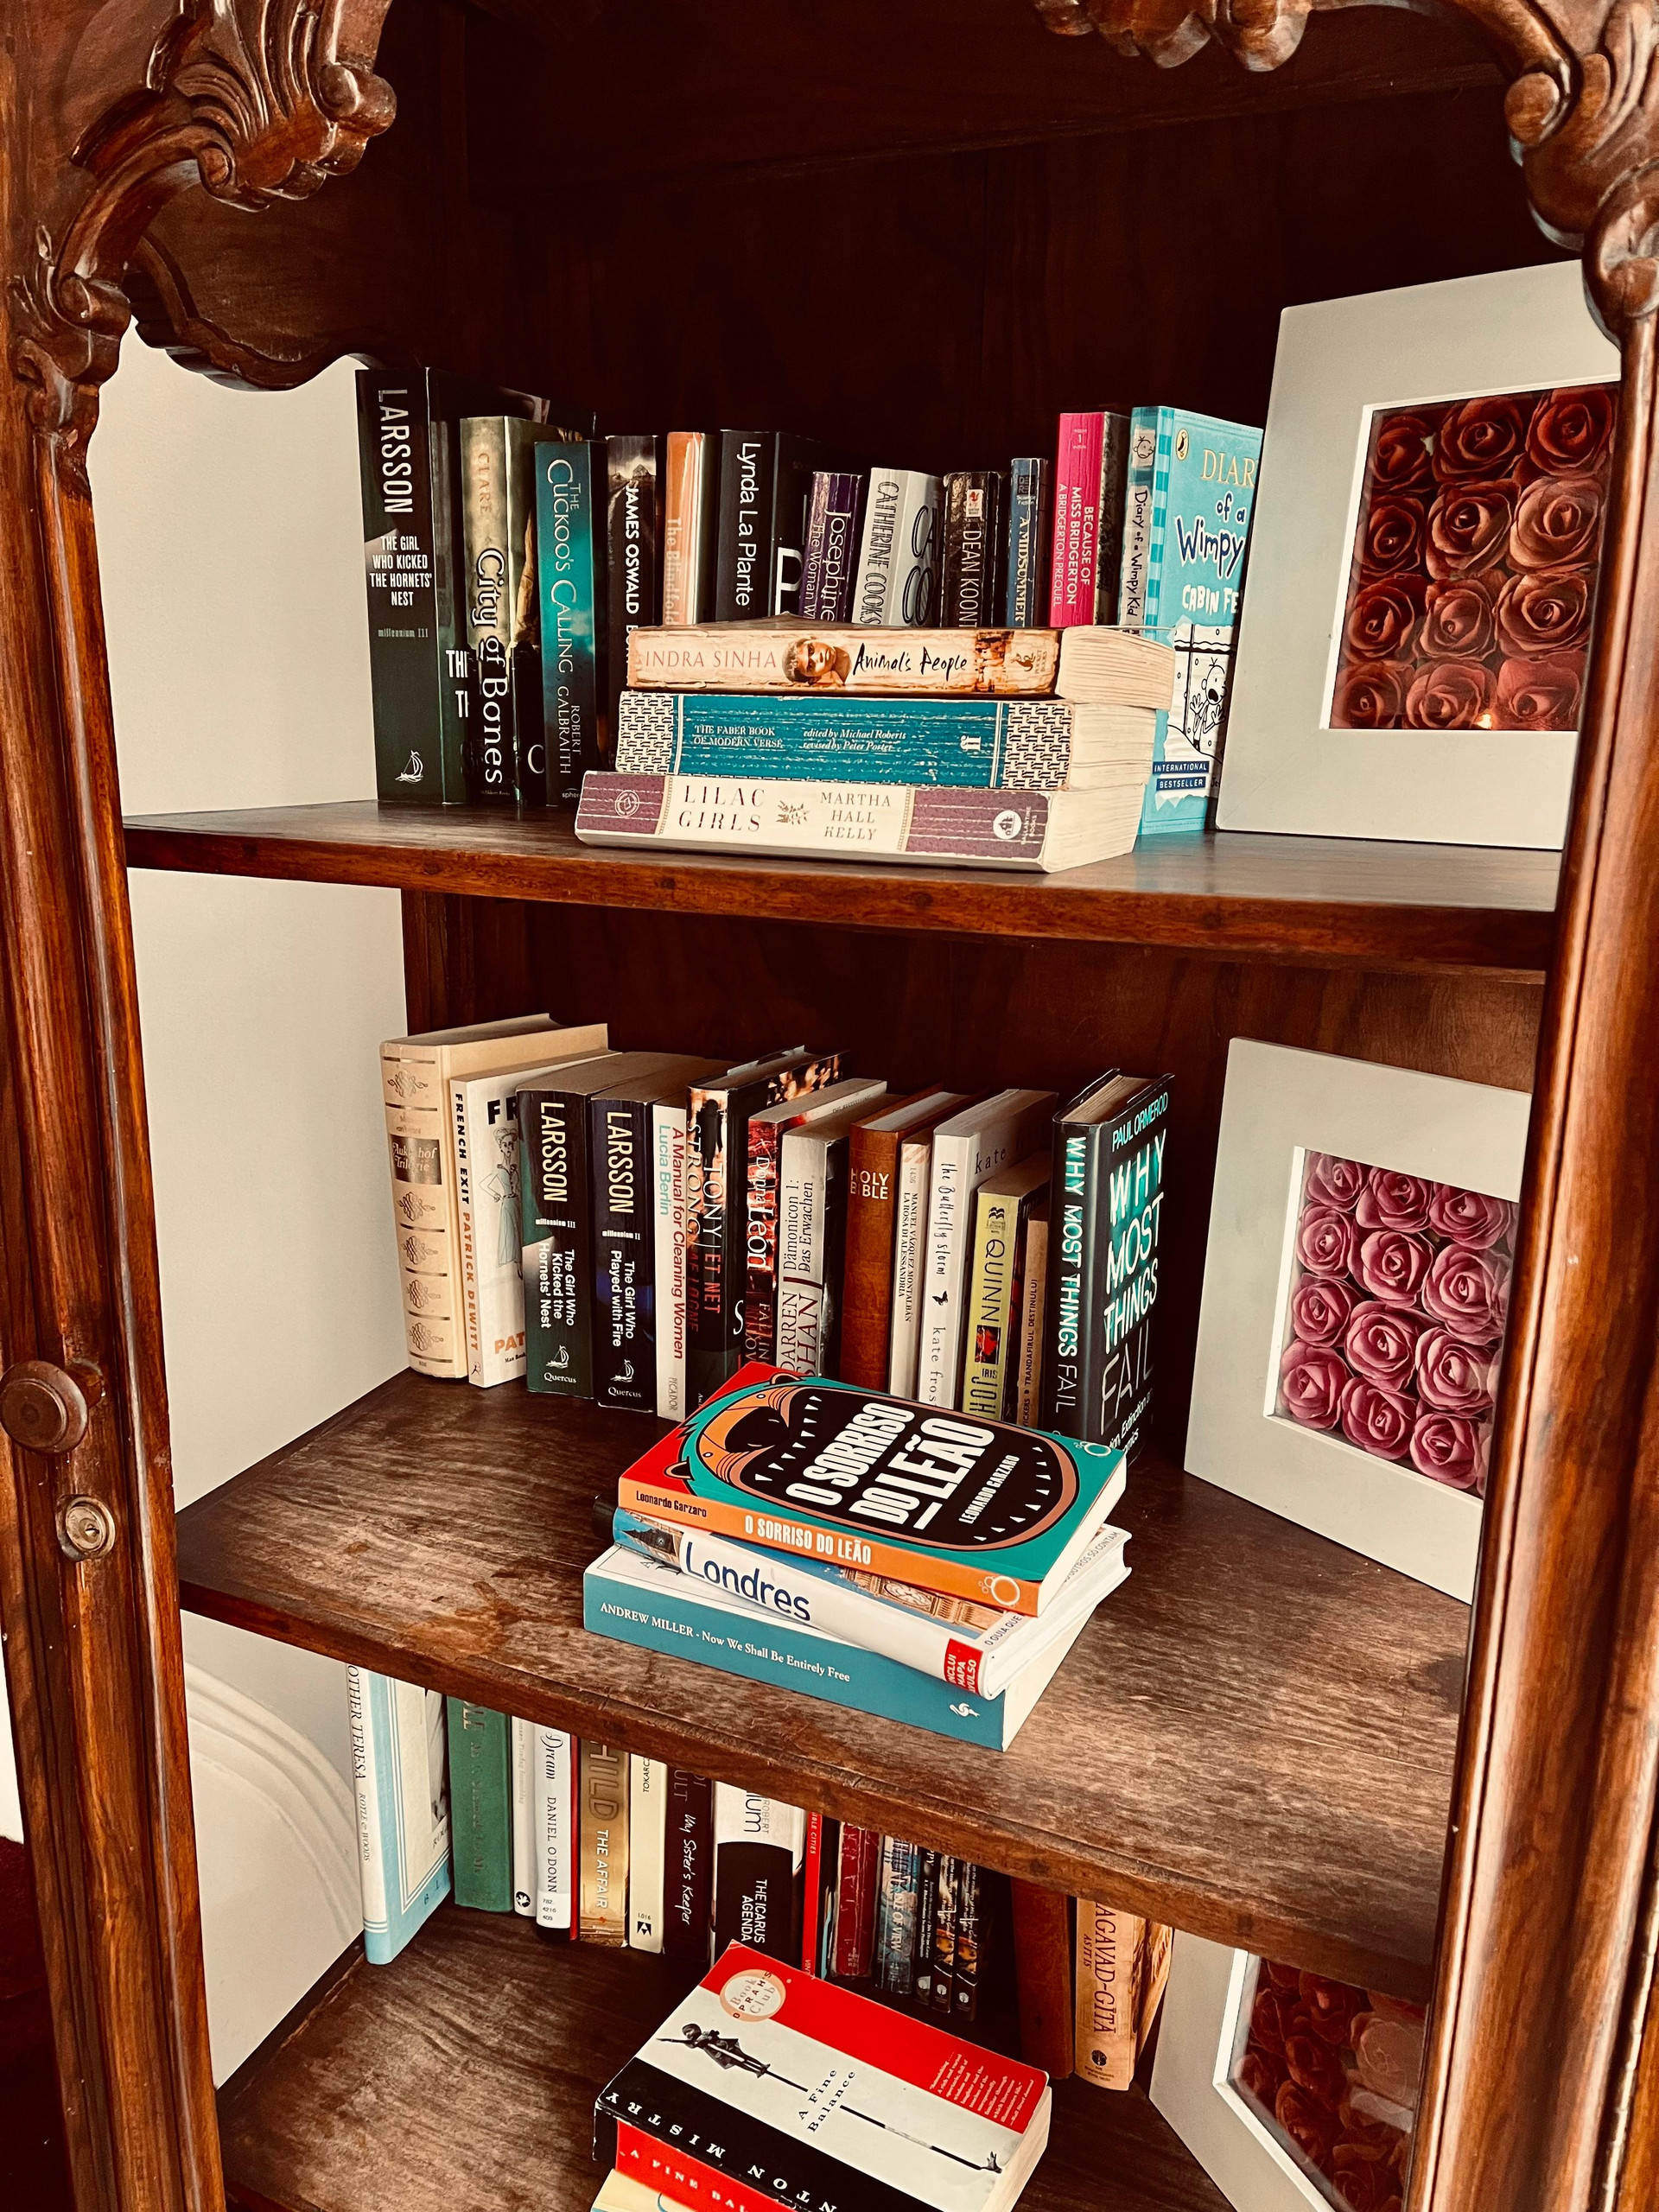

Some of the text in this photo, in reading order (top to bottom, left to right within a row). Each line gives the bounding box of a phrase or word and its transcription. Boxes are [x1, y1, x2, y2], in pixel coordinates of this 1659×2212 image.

[378, 390, 413, 512] LARSSON
[478, 453, 491, 513] CLARE
[569, 483, 581, 510] THE
[380, 536, 419, 550] THE GIRL
[626, 480, 639, 614] JAMES OSWALD
[735, 442, 761, 606] Lynda La Plante
[868, 481, 899, 569] CATHERINE
[961, 530, 982, 572] DEAN
[1053, 494, 1067, 607] BRIDGERTON PREQUEL
[1067, 486, 1082, 604] MISS BRIDGERTON
[1081, 506, 1095, 585] BECAUSE OF
[1126, 490, 1147, 616] Diary Wimpy Kid
[1175, 516, 1245, 579] Wimpy
[369, 573, 432, 588] THE HORNETS'
[372, 555, 428, 569] WHO KICKED
[472, 548, 505, 627] City
[547, 459, 576, 673] CUCKOO'S CALLING
[821, 509, 851, 621] Josephine
[1015, 528, 1029, 621] MIDSUMMER
[391, 591, 414, 607] NEST
[1182, 584, 1219, 615] CABIN
[485, 636, 505, 668] of
[645, 651, 777, 668] INDRA SINHA
[853, 643, 968, 681] Animal's People
[482, 677, 508, 784] Bones
[557, 686, 571, 773] GALBRAITH
[571, 705, 581, 754] ROBERT
[694, 725, 775, 736] THE FABER BOOK
[709, 736, 751, 747] MODERN
[803, 729, 906, 740] edited Michael Roberts
[683, 784, 766, 808] LILAC
[1154, 763, 1207, 772] INTERNATIONAL
[1159, 779, 1204, 789] BESTSELLER
[678, 809, 761, 832] GIRLS
[820, 791, 892, 807] MARTHA
[831, 810, 875, 823] HALL
[823, 826, 877, 841] KELLY
[455, 1093, 470, 1205] FRENCH EXIT
[540, 1102, 568, 1202] LARSSON
[1112, 1092, 1169, 1153] PAUL ORMEROD
[607, 1111, 634, 1214] LARSSON
[659, 1125, 671, 1216] Lucia Berlin
[686, 1123, 702, 1236] STRONG
[850, 1183, 888, 1199] BIBLE
[851, 1168, 889, 1186] HOLY
[975, 1147, 1007, 1174] kate
[1109, 1128, 1166, 1227] WHY
[703, 1163, 723, 1238] TONY
[747, 1156, 774, 1268] Donna Leon
[798, 1182, 813, 1274] Das Erwachen
[671, 1145, 685, 1359] Manual for Cleaning Women
[784, 1196, 799, 1271] Dämonicon
[1107, 1192, 1164, 1294] MOST
[462, 1211, 479, 1351] PATRICK DEWITT
[538, 1243, 552, 1329] Hornets' Nest
[551, 1252, 563, 1319] Kicked the
[564, 1249, 576, 1326] The Girl Who
[609, 1250, 623, 1347] Played with Fire
[899, 1238, 907, 1297] ALESSANDRIA
[981, 1238, 1005, 1323] QUINN
[1055, 1136, 1086, 1414] WHY MOST THINGS FAIL
[624, 1262, 636, 1339] The Girl Who
[1103, 1257, 1158, 1355] THINGS
[780, 1292, 798, 1372] DARREN
[931, 1326, 946, 1363] kate
[1025, 1279, 1038, 1386] TRANDAFIRUL DESTINULUI
[543, 1372, 577, 1383] Quercus
[607, 1386, 642, 1398] Quercus
[668, 1377, 677, 1412] PICADOR
[1101, 1318, 1154, 1436] FAIL
[803, 1402, 915, 1487] SORRISO
[875, 1417, 995, 1500] LEÃO
[636, 1491, 707, 1518] Leonardo Garzaro
[958, 1454, 1020, 1524] LEONARDO GARZARO
[757, 1518, 872, 1566] SORRISO DO LEÃO
[685, 1541, 811, 1622] Londres
[601, 1602, 850, 1682] ANDREW MILLER Now We Shall Be Entirely Free
[990, 1627, 1007, 1642] GUIA
[957, 1661, 966, 1687] MAPA
[352, 1725, 367, 1779] TERESA
[540, 1732, 563, 1780] Dream
[547, 1796, 557, 1841] DANIEL
[596, 1829, 609, 1856] THE
[761, 1800, 771, 1834] ROBERT
[596, 1859, 609, 1909] AFFAIR
[675, 1814, 696, 1925] My Sister's Keeper
[741, 1896, 753, 1942] AGENDA
[754, 1879, 767, 1943] THE ICARUS
[730, 1979, 757, 2005] Book
[733, 1972, 772, 2018] OPRAH'S
[749, 1986, 776, 2014] Club
[808, 2071, 855, 2132] Balance
[809, 2069, 836, 2103] Fine
[606, 2092, 726, 2158] MISTRY
